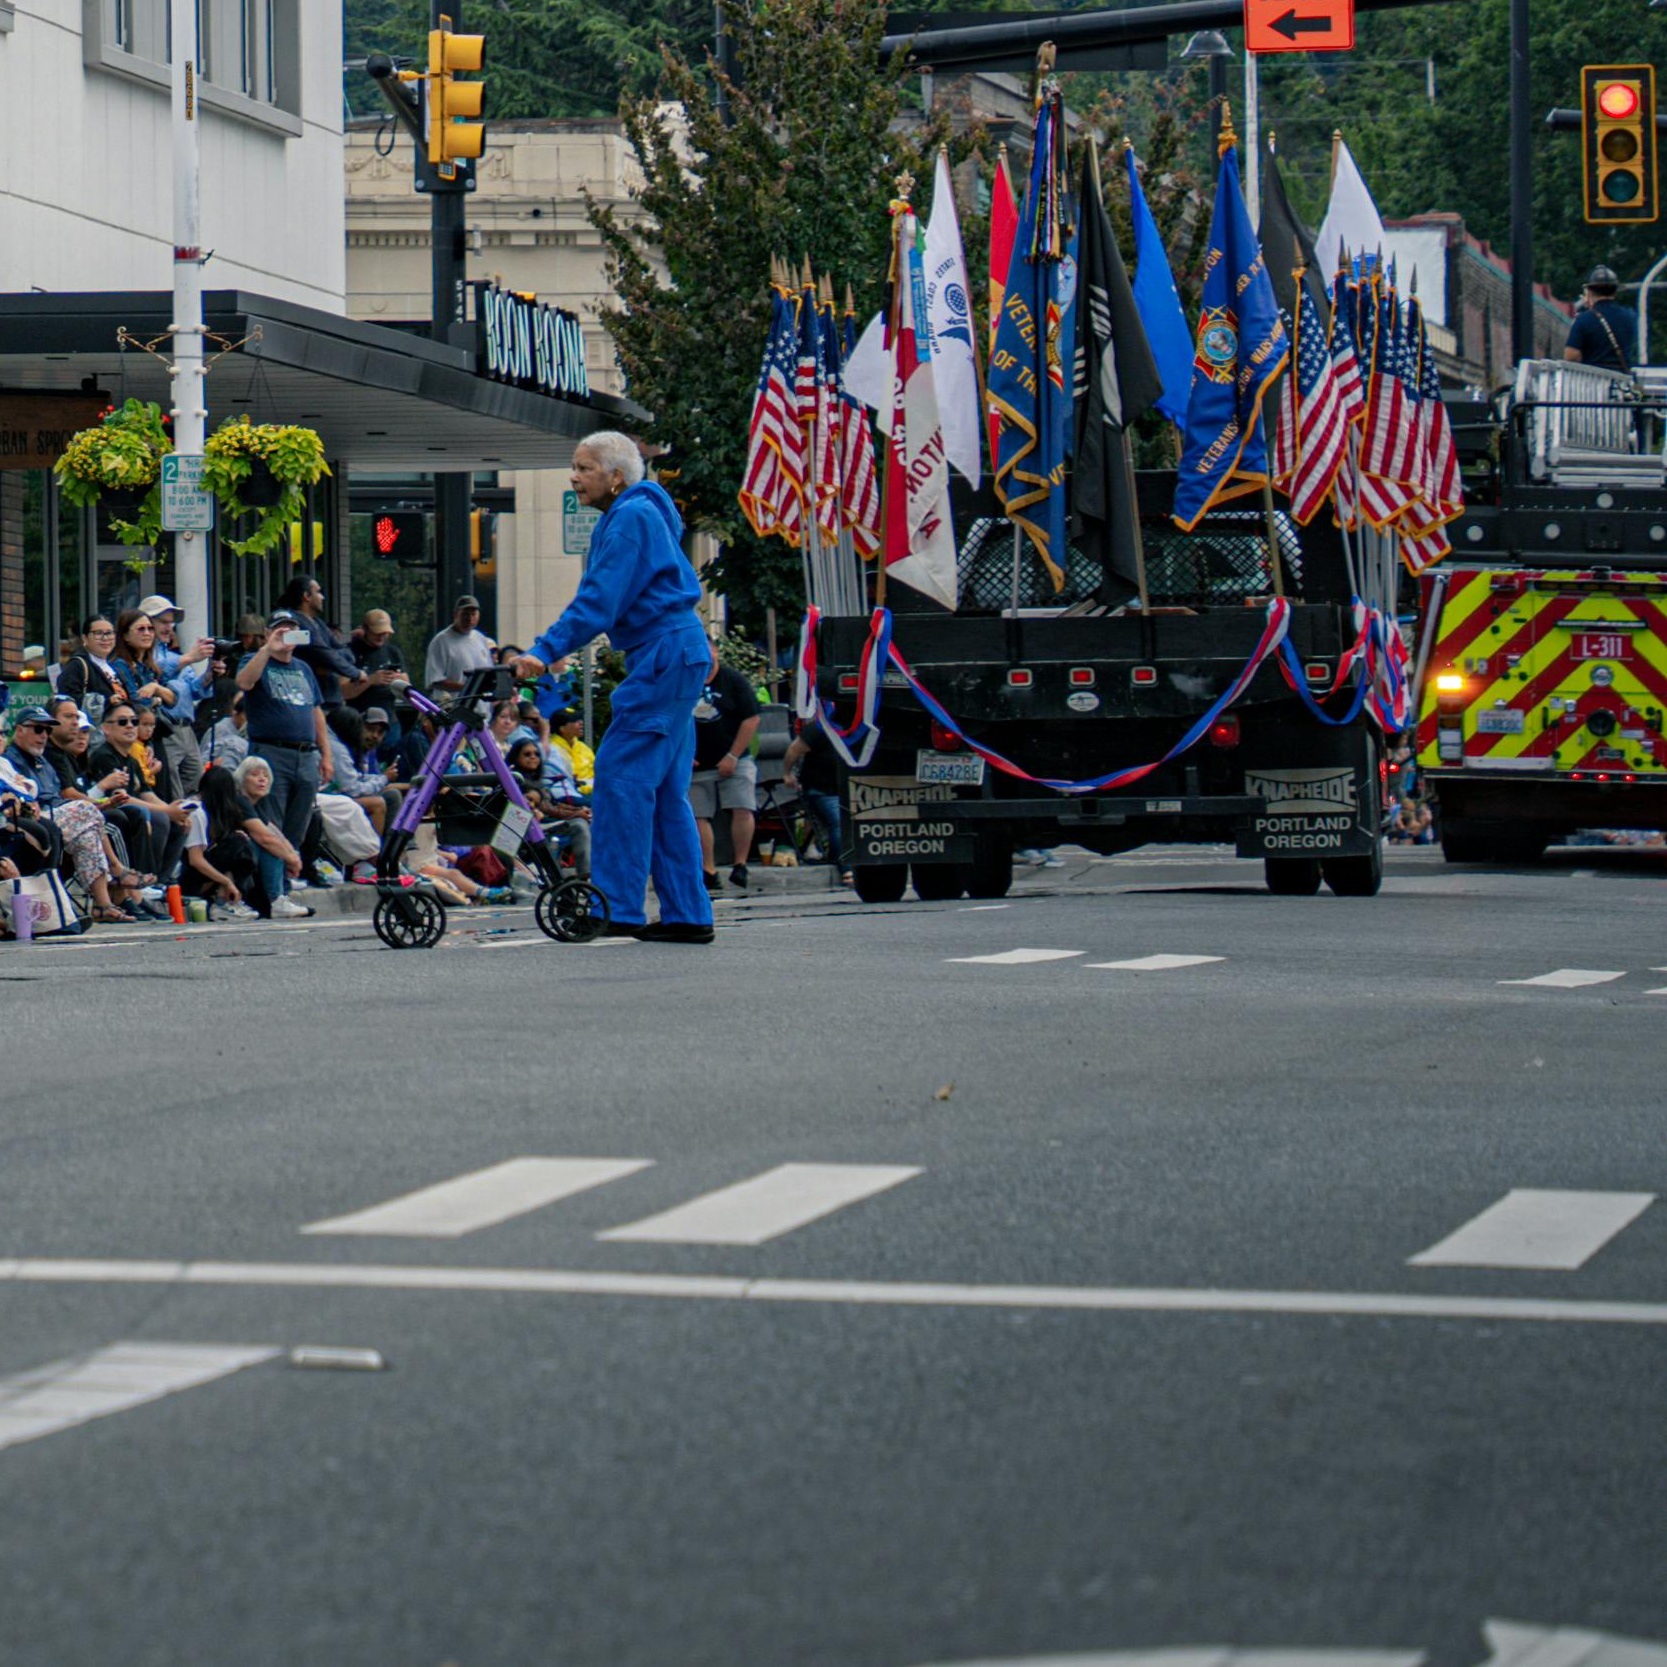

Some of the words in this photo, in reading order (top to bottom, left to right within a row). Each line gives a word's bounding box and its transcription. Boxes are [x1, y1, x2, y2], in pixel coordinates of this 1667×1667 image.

[484, 290, 532, 379] BOON
[993, 349, 1017, 371] OF
[166, 462, 177, 481] 2
[566, 496, 576, 512] 2
[1581, 636, 1623, 657] L-311
[859, 823, 954, 838] PORTLAND
[1255, 817, 1351, 832] PORTLAND
[868, 840, 944, 855] OREGON
[1264, 834, 1342, 848] OREGON
